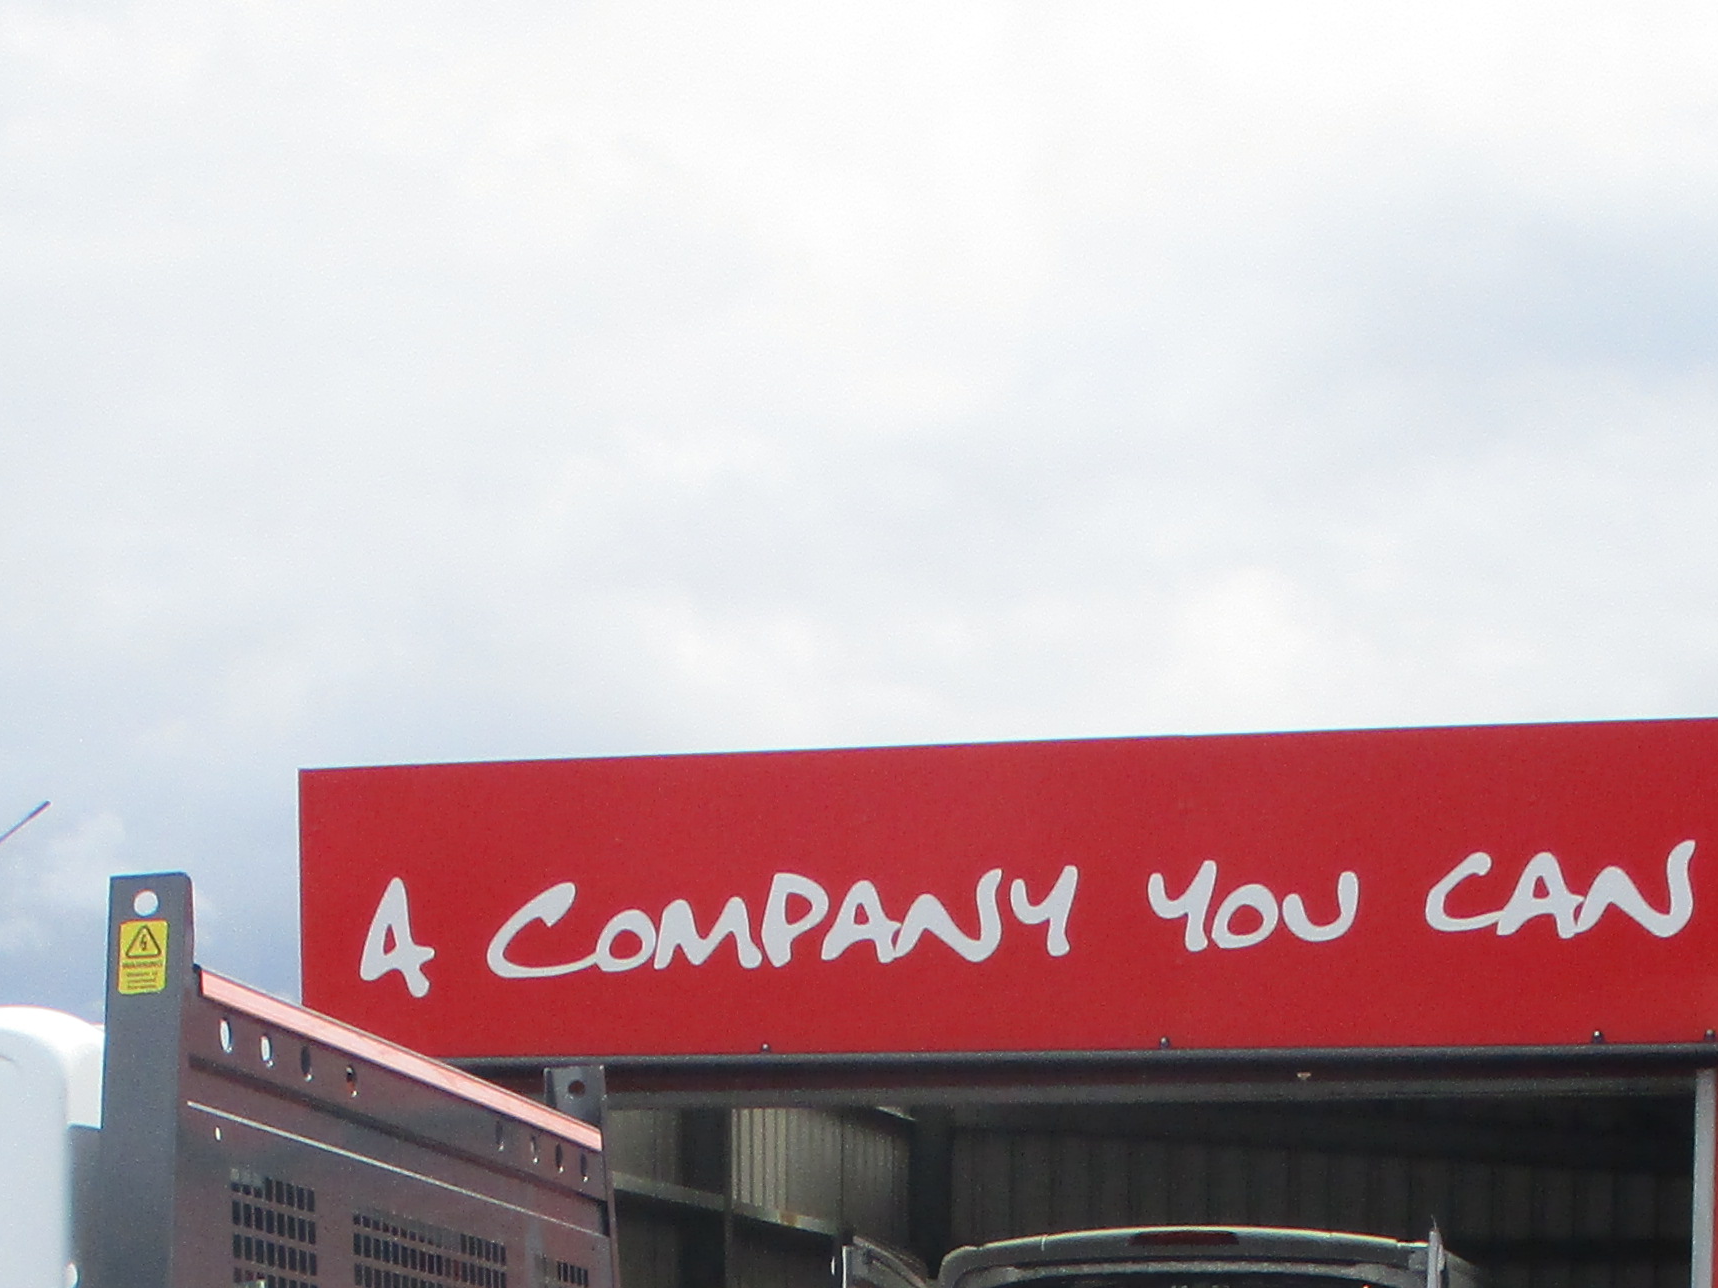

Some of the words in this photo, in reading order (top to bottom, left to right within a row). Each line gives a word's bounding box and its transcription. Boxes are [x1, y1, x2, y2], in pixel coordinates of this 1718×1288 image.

[358, 876, 437, 998] A
[485, 864, 1080, 979] COMPANY
[1146, 858, 1360, 952] YOU
[1424, 838, 1697, 939] CAN
